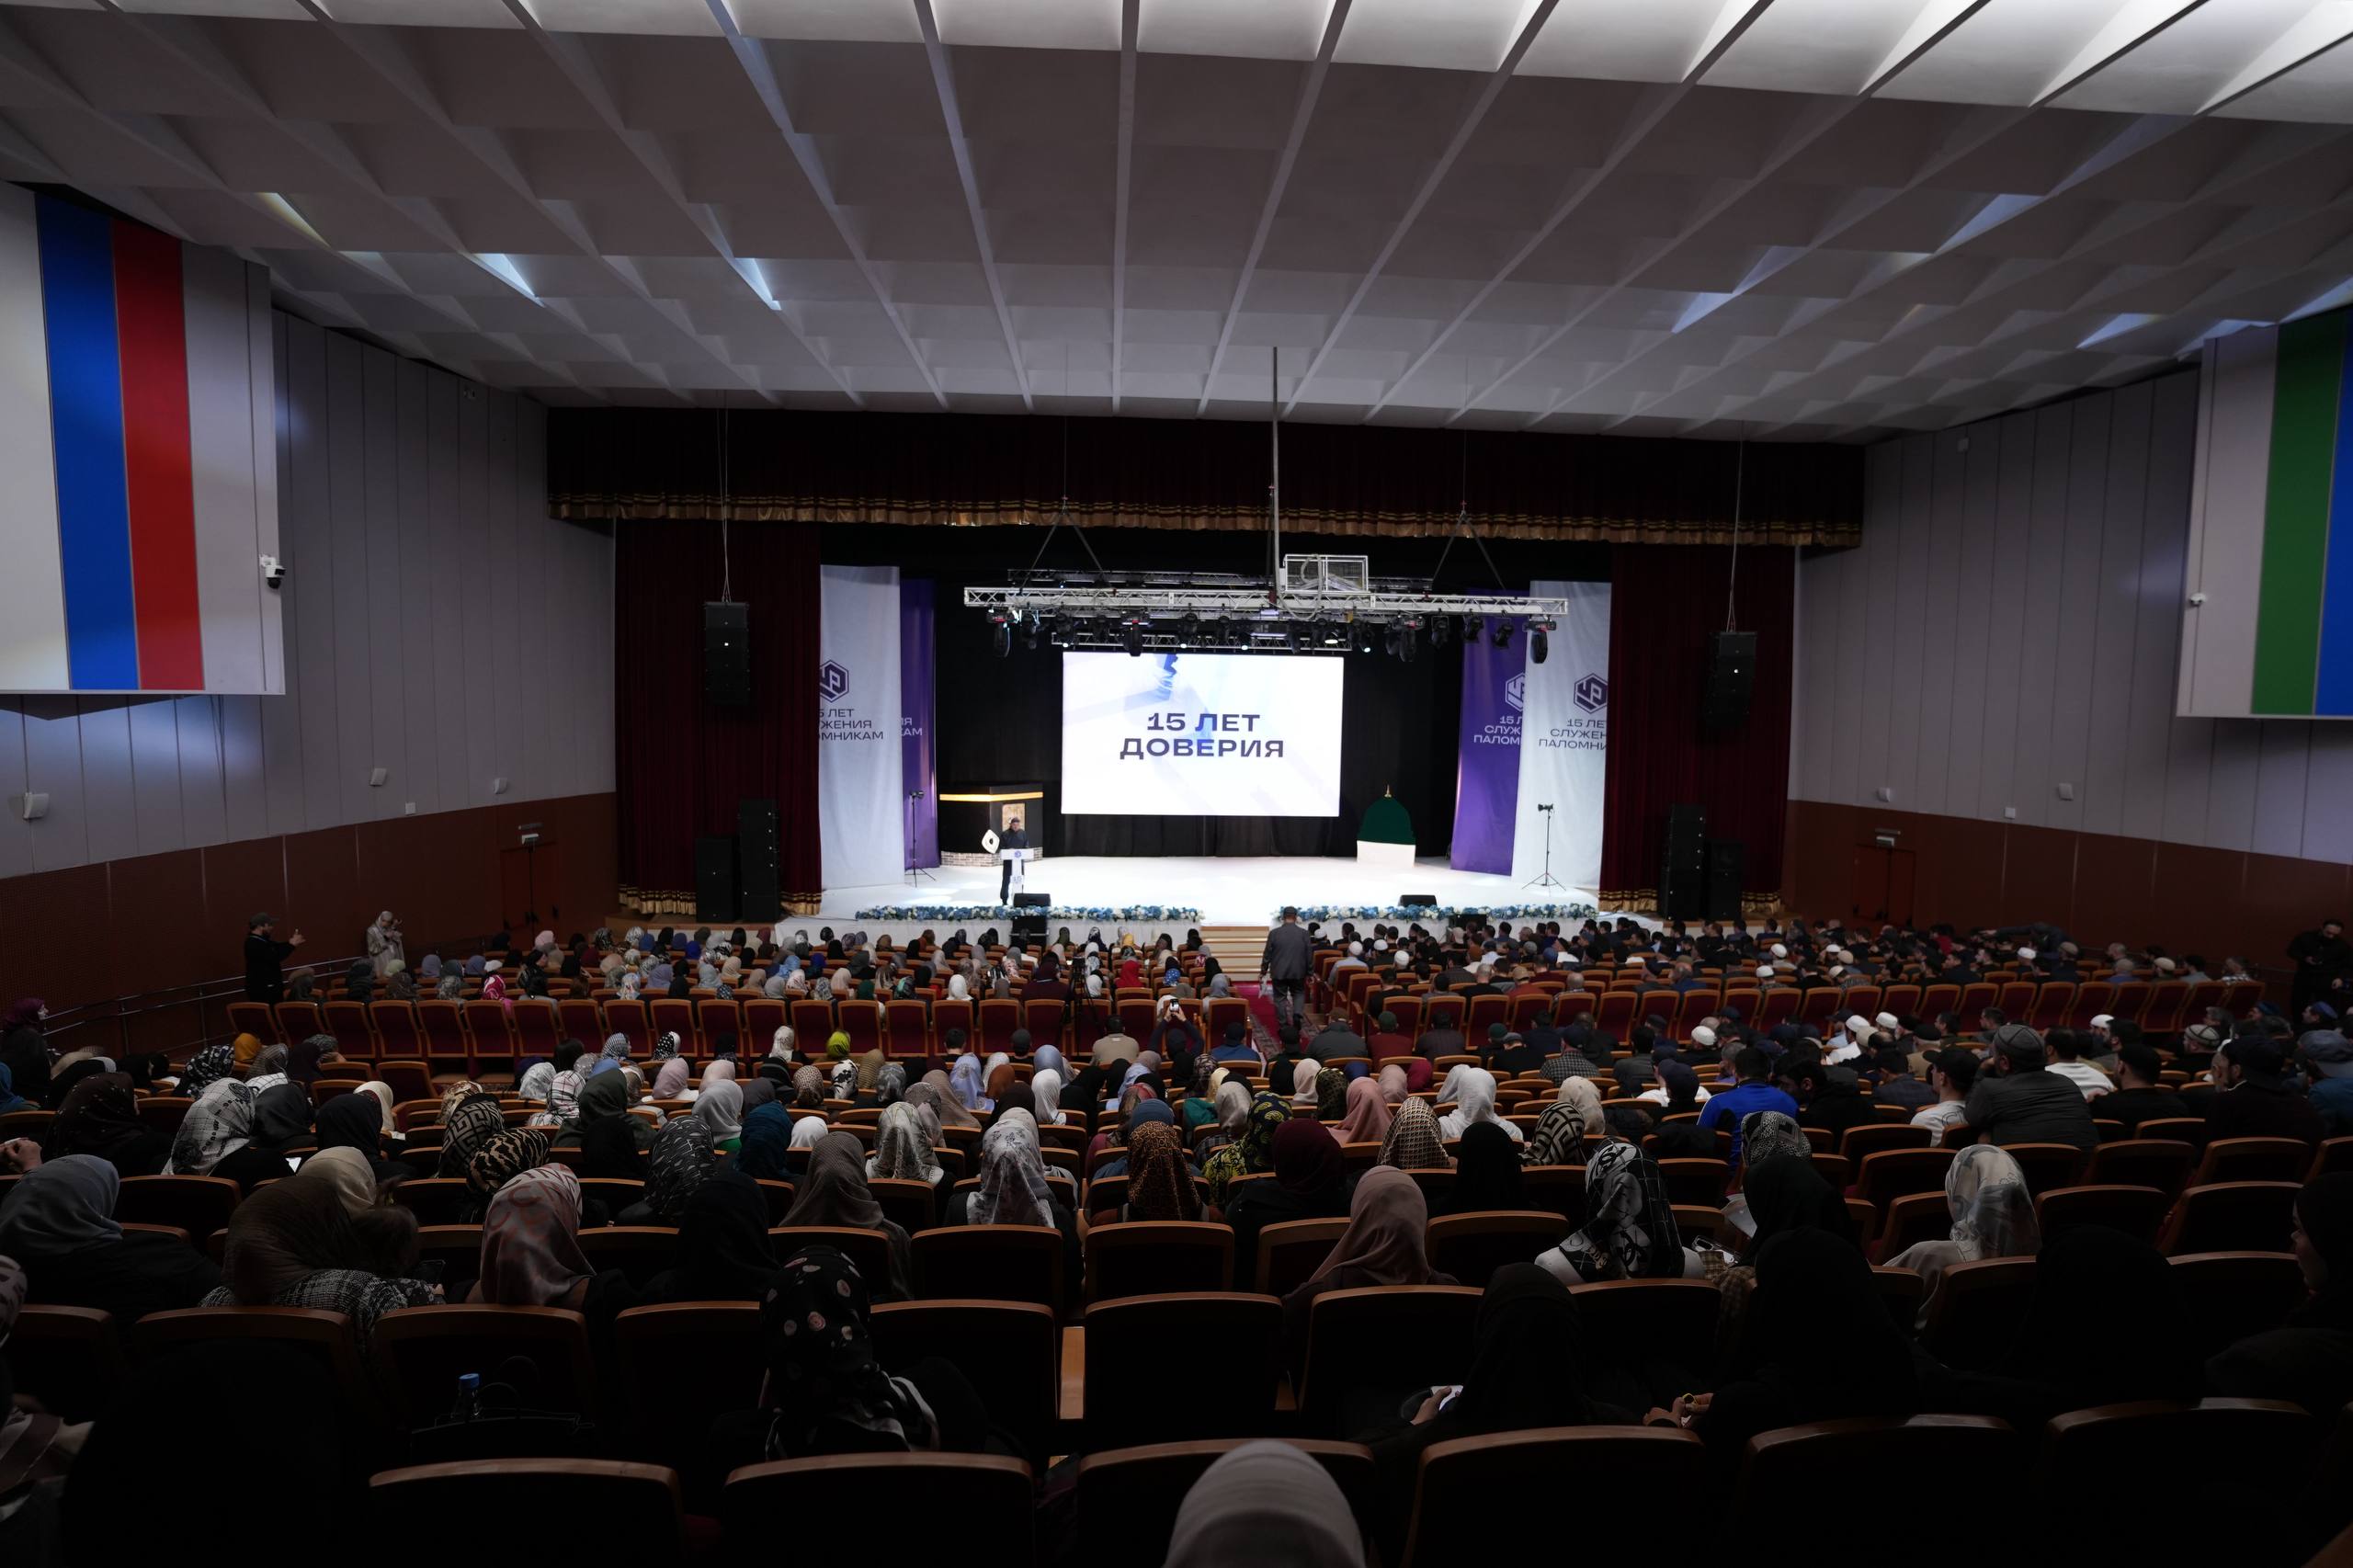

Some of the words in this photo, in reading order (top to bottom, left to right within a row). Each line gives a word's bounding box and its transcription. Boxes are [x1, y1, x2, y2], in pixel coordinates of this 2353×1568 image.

[828, 709, 854, 718] ЛЕТ
[821, 720, 872, 729] ЖЕНИЯ
[1147, 712, 1186, 731] 15
[1195, 713, 1260, 733] ЛЕТ
[1500, 716, 1515, 724] 15
[1567, 719, 1583, 727] 15
[1586, 720, 1607, 729] ЛЕ
[1484, 725, 1521, 734] СЛУЖ
[1551, 729, 1607, 740] СЛУЖЕН
[821, 732, 883, 741] МНИКАМ
[1473, 735, 1520, 745] ПАЛОМ
[1120, 738, 1284, 760] ДОВЕРИЯ
[1539, 738, 1607, 750] ПАЛОМНИ
